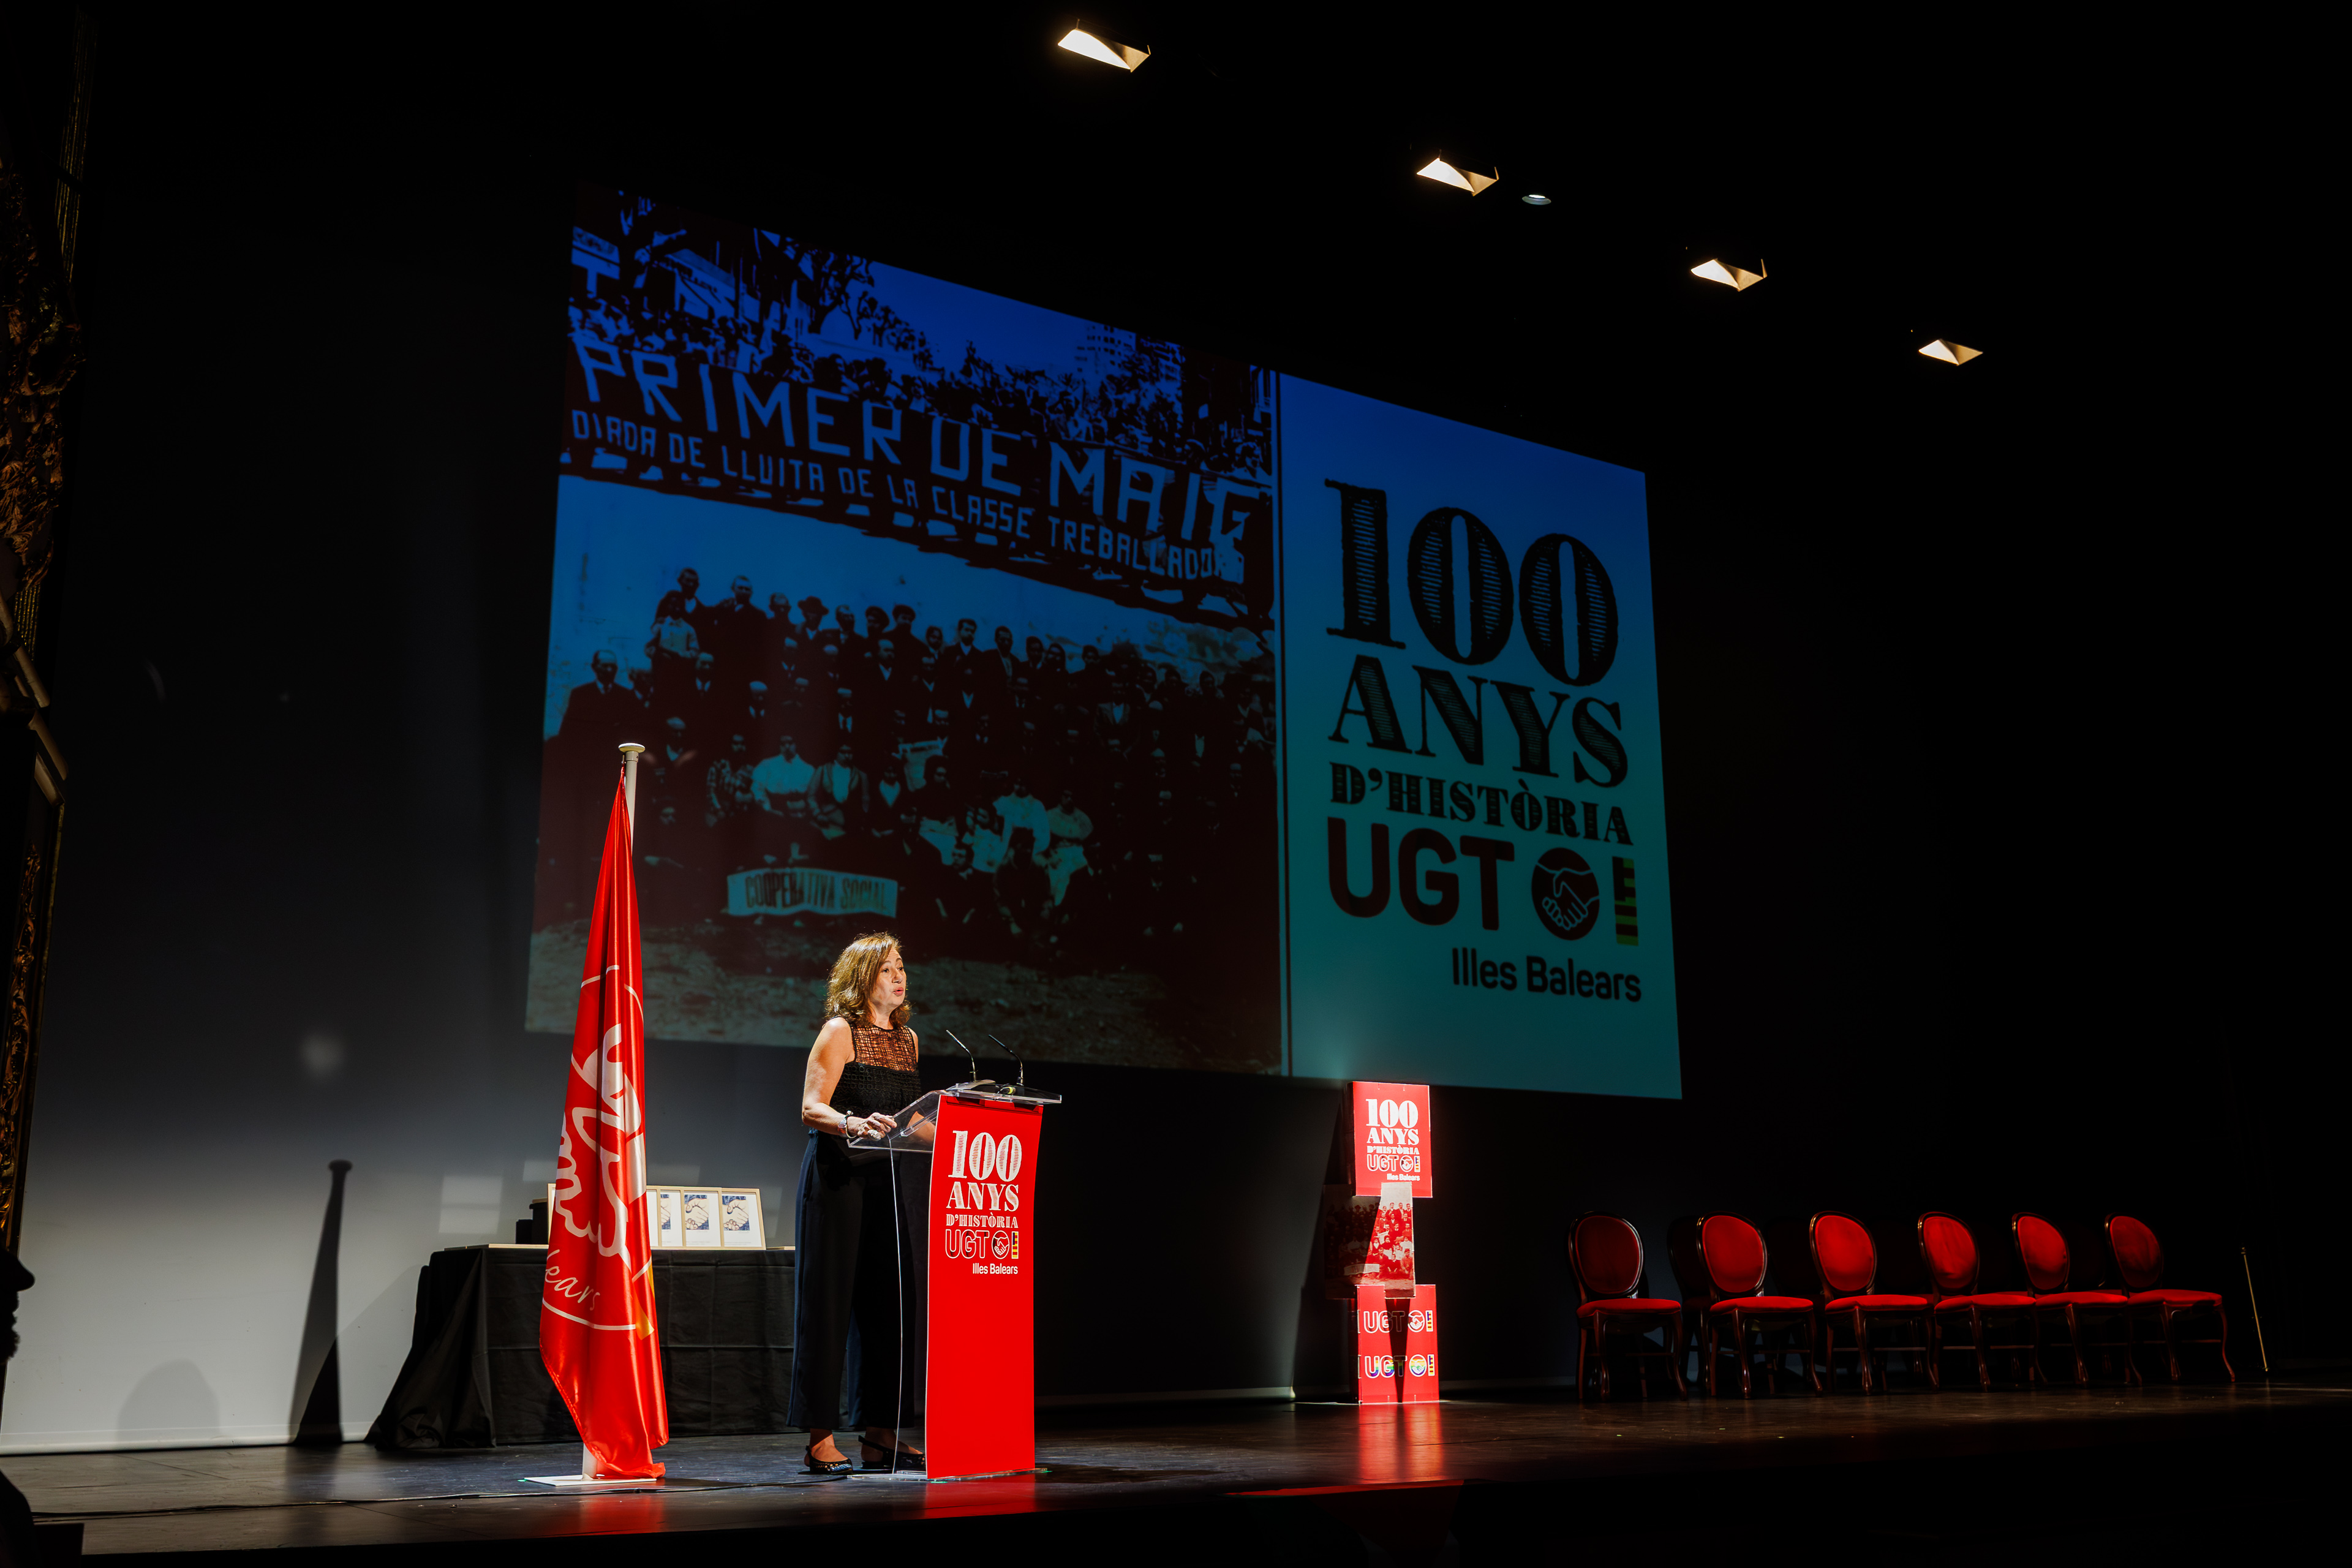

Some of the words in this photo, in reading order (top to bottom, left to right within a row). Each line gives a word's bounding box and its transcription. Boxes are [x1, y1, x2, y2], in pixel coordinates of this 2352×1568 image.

[574, 339, 902, 465] PRIMER
[930, 416, 1022, 497] DE
[1048, 441, 1260, 542] MAIG
[571, 409, 657, 458] DIADA
[669, 432, 706, 469] DE
[722, 445, 825, 492] LLUITA
[839, 467, 874, 498] DE
[887, 474, 919, 509] LA
[932, 485, 1036, 540] CLASSE
[1324, 478, 1619, 687] 100
[1328, 654, 1628, 788] ANYS
[1329, 761, 1634, 846] D'HISTÒRIA
[1327, 816, 1515, 931] UGT
[1452, 947, 1518, 991] Illes
[1526, 955, 1642, 1002] Balears
[1365, 1099, 1419, 1128] 100
[1366, 1128, 1420, 1145] ANYS
[948, 1130, 1022, 1182] 100
[1367, 1154, 1399, 1171] UGT
[946, 1182, 1019, 1212] ANYS
[946, 1212, 1019, 1228] D'HISTÒRIA
[945, 1229, 990, 1259] UGT
[973, 1263, 989, 1275] Illes
[990, 1263, 1018, 1275] Balears
[1363, 1310, 1406, 1333] UGT
[1364, 1354, 1408, 1379] UGT
